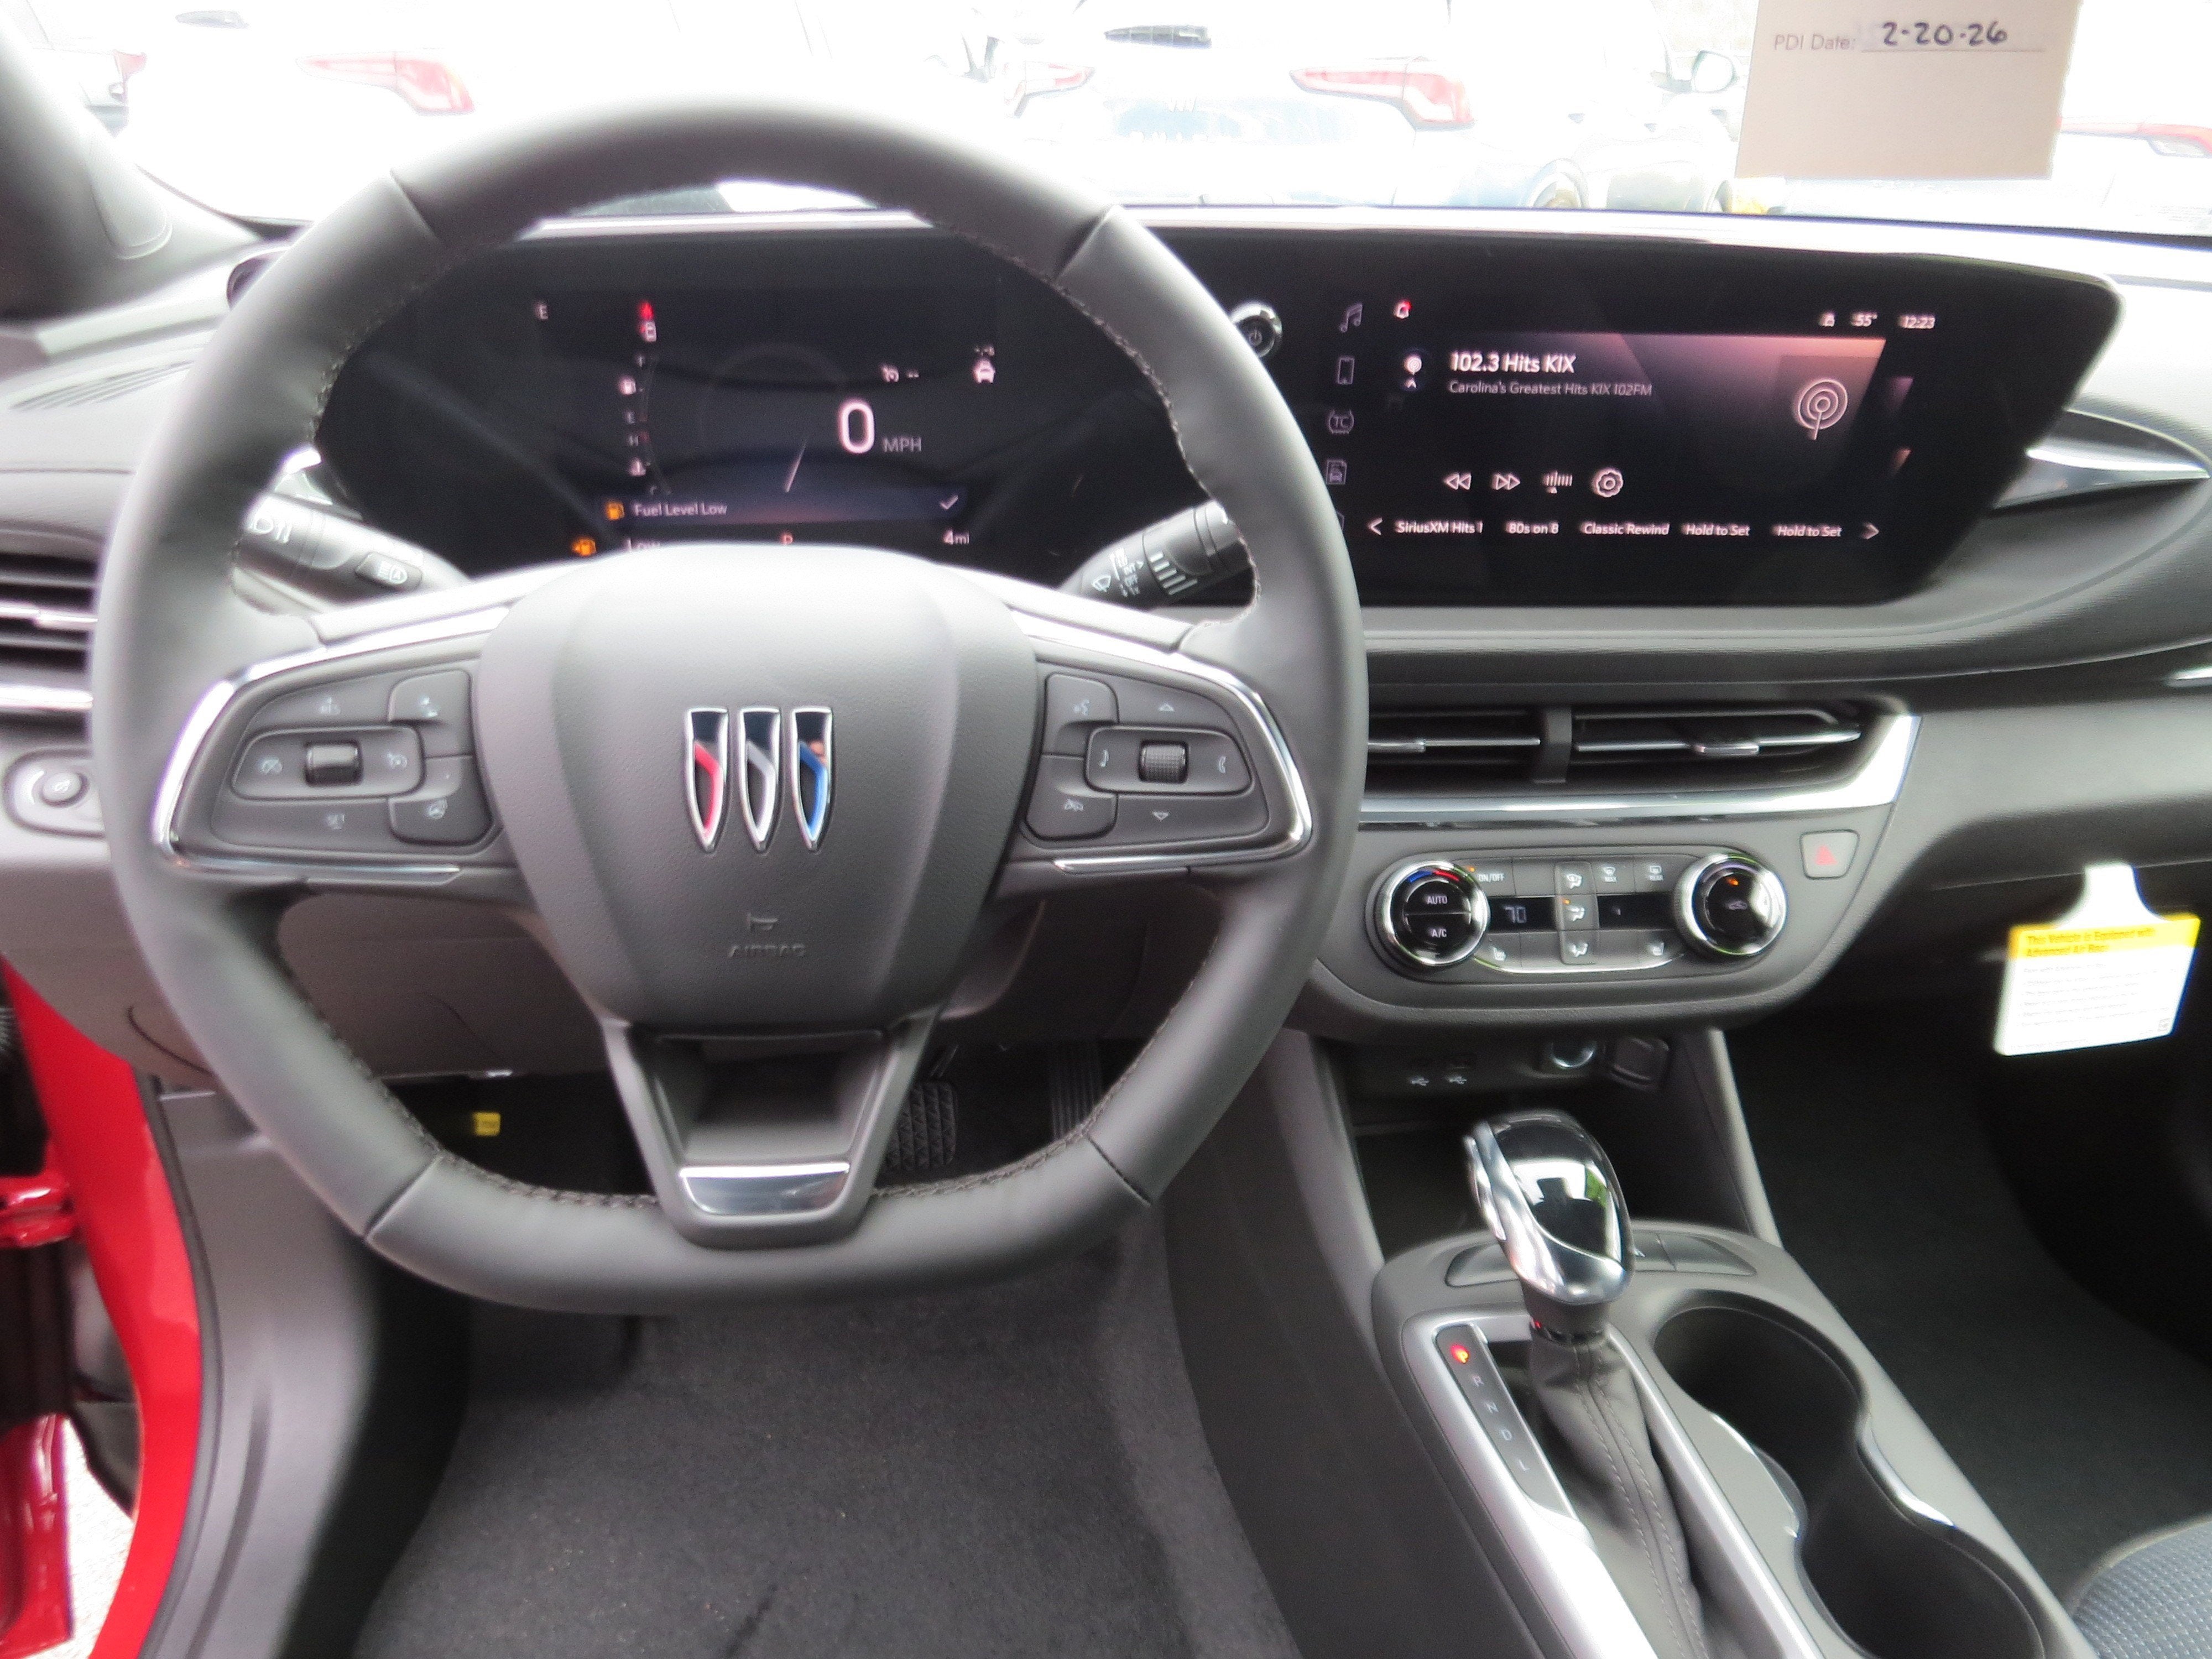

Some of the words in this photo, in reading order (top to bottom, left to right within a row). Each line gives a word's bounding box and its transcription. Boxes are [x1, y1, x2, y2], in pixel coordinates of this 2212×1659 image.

[1774, 33, 1803, 50] PDI
[1811, 33, 1856, 50] Date:
[1901, 315, 1936, 329] 12:23
[1449, 352, 1499, 372] 102.3
[1502, 352, 1540, 373] Hits
[1543, 354, 1577, 373] KIX
[1449, 380, 1506, 394] Carolina's
[1510, 382, 1561, 395] Greatest
[1564, 383, 1588, 395] Hits
[1591, 384, 1610, 396] KIX
[1614, 384, 1652, 397] 102FM
[837, 397, 875, 454] 0
[884, 436, 922, 452] MPH
[633, 502, 662, 516] Fuel
[663, 502, 698, 515] Level
[701, 502, 727, 515] Low
[1395, 520, 1449, 534] SiriusXM
[1452, 520, 1475, 534] Hits
[1507, 521, 1530, 534] 80s
[1533, 524, 1548, 534] on
[1550, 521, 1559, 534] 8
[1582, 521, 1624, 535] Classic
[1626, 521, 1670, 535] Rewind
[1683, 522, 1714, 535] Hold
[1716, 524, 1728, 535] to
[1730, 523, 1750, 536] Set
[1775, 523, 1806, 536] Hold
[1807, 525, 1820, 536] to
[1821, 525, 1842, 537] Set
[1478, 873, 1505, 882] ON/OFF
[1426, 895, 1448, 905] AUTO
[1504, 905, 1527, 924] 70
[1431, 928, 1447, 938] A/C
[1472, 1375, 1485, 1387] R
[1485, 1401, 1499, 1413] N
[1500, 1428, 1513, 1441] D
[1518, 1460, 1530, 1472] L
